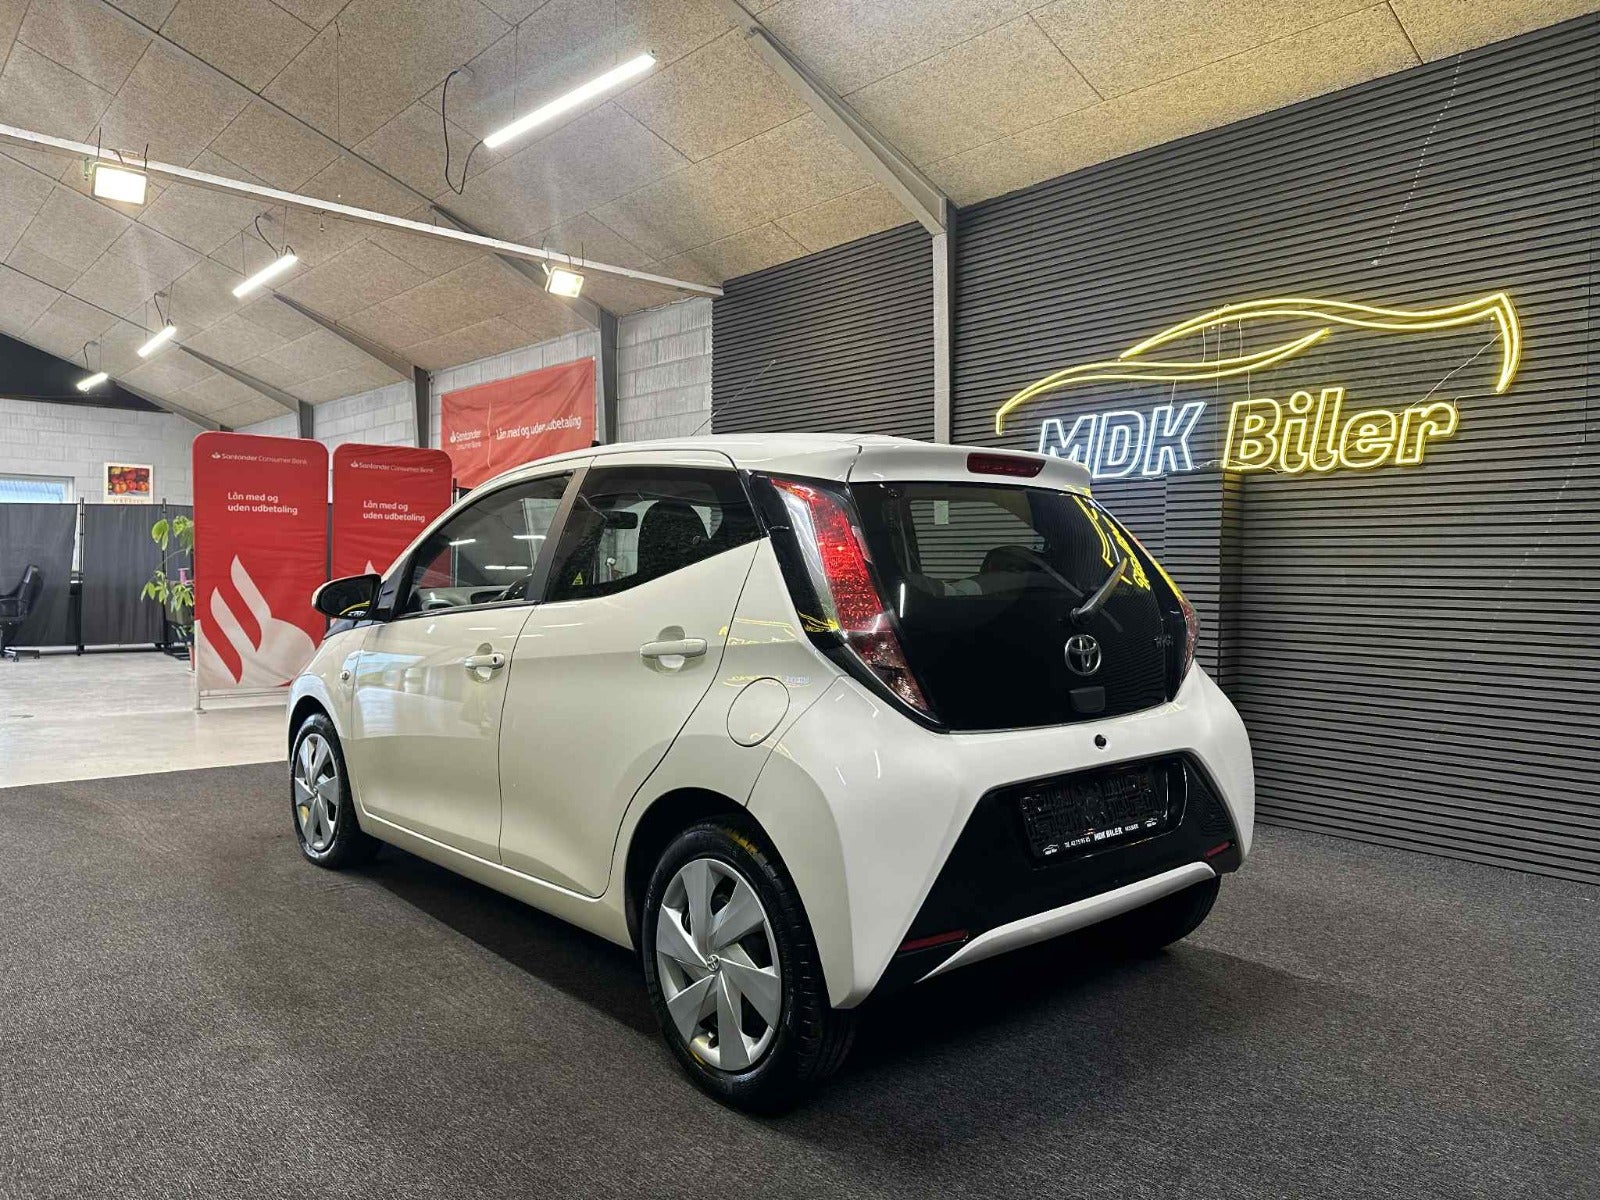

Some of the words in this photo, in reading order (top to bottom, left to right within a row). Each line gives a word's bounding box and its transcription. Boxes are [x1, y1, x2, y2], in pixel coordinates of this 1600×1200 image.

[520, 426, 530, 439] og
[1038, 401, 1207, 479] MDK
[1223, 386, 1460, 475] Biler
[221, 453, 257, 461] Santander
[359, 461, 390, 471] Santander
[227, 491, 244, 500] Lån
[227, 503, 250, 512] uden
[251, 505, 298, 516] udbetaling
[363, 500, 378, 509] Lån
[379, 502, 397, 510] med
[398, 504, 408, 512] og
[363, 511, 383, 519] uden
[384, 513, 426, 523] udbetaling
